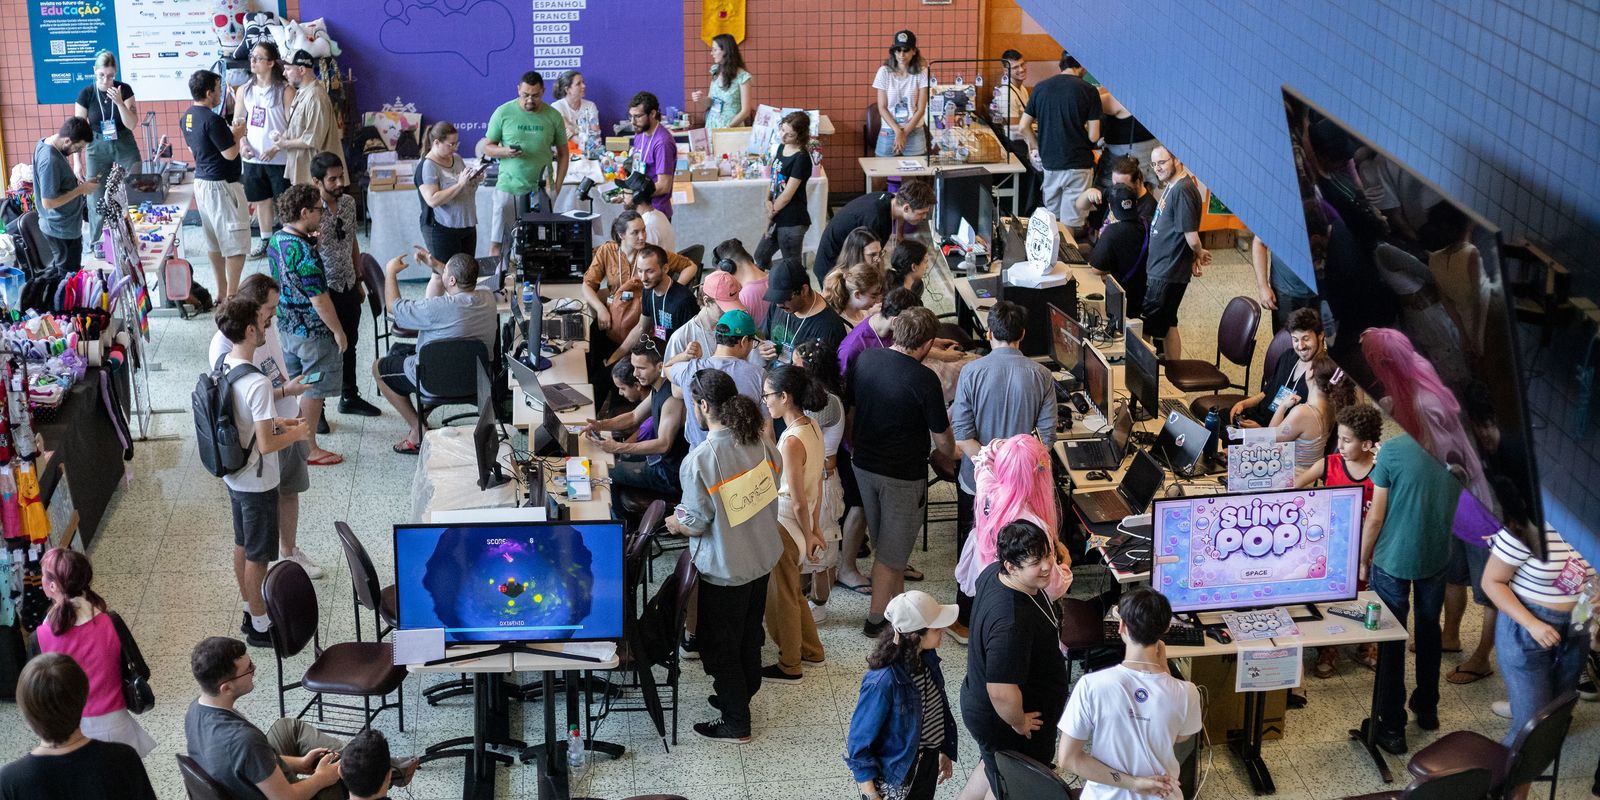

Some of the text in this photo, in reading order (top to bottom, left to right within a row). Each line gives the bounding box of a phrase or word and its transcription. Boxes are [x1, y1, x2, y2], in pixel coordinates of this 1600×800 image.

[1239, 460, 1282, 478] POP
[1214, 523, 1302, 560] POP
[1239, 619, 1282, 633] POP
